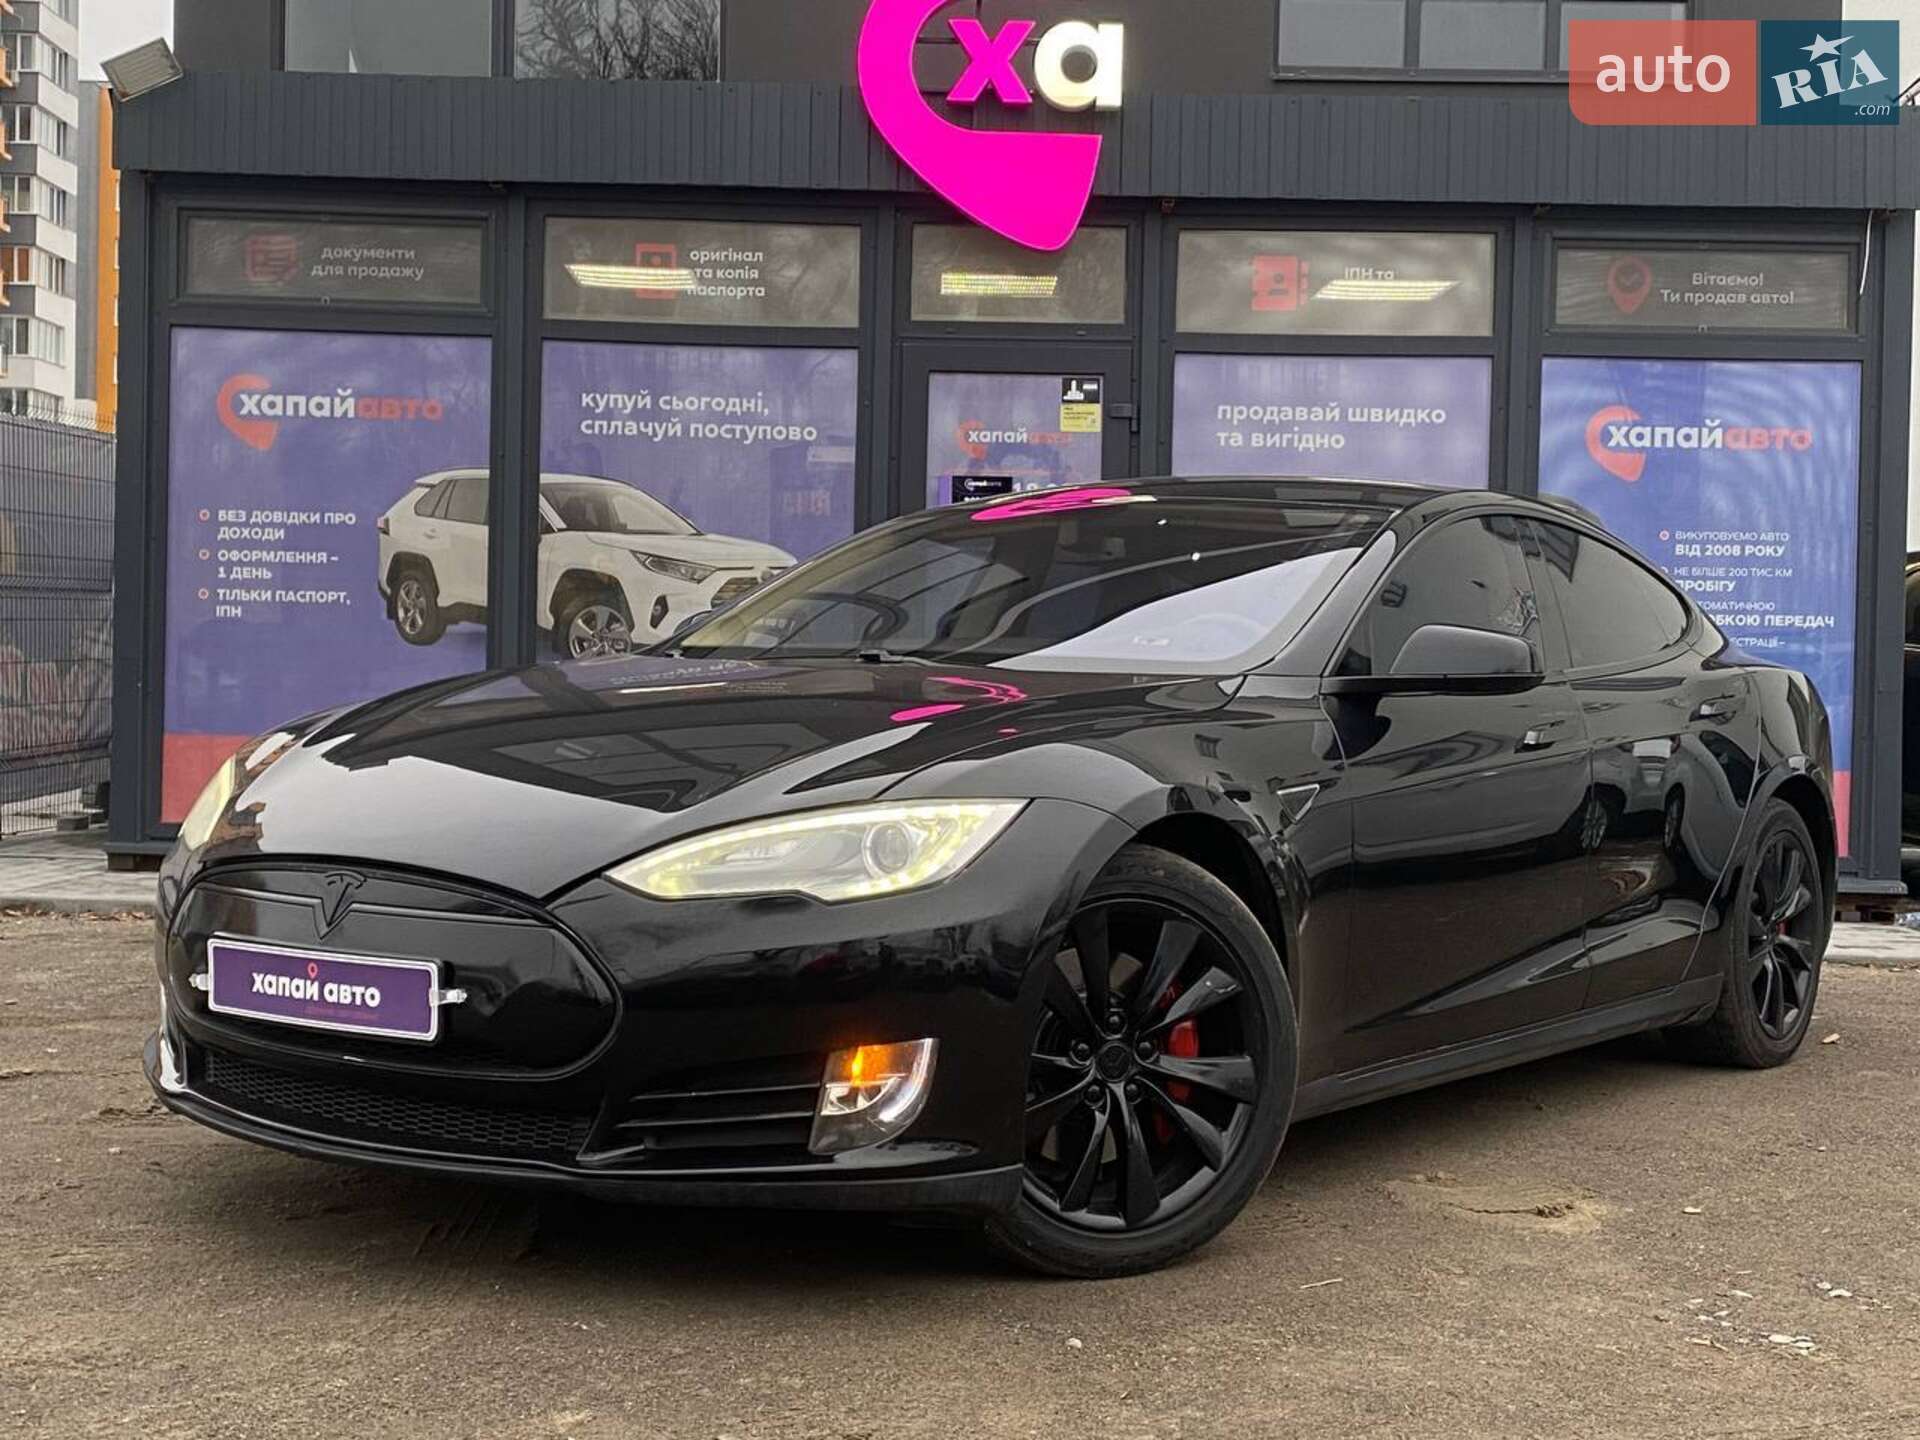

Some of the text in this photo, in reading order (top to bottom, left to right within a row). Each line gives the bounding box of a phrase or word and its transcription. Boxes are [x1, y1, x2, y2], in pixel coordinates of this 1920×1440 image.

[321, 247, 415, 262] документи
[689, 247, 764, 265] оригінал
[311, 264, 424, 281] для продажу
[694, 265, 759, 279] та копія
[1344, 266, 1394, 281] ІПН та
[1691, 271, 1764, 287] Вітаємо!
[1660, 288, 1794, 306] Ти продав авто!
[580, 391, 769, 416] купуй сьогодні,
[1216, 402, 1447, 426] продавай швидко
[580, 418, 818, 445] сплачуй поступово
[1216, 427, 1345, 451] та вигідно
[217, 509, 356, 525] БЕЗ ДОВІДКИ ПРО
[217, 526, 285, 542] ДОХОДИ
[1675, 530, 1790, 542] ВИКУПОВУЄМО АВТО
[217, 549, 327, 564] ОФОРМЛЕННЯ
[1675, 543, 1785, 558] ВІД 2008 РОКУ
[217, 566, 272, 581] 1 ДЕНЬ
[1674, 566, 1690, 577] НЕ
[1729, 567, 1748, 577] 200
[1775, 569, 1793, 577] КМ
[216, 588, 351, 605] ТІЛЬКИ ПАСПОРТ,
[215, 604, 242, 618] ІПН
[1763, 614, 1835, 629] ПЕРЕДАЧ
[323, 980, 381, 1008] авто
